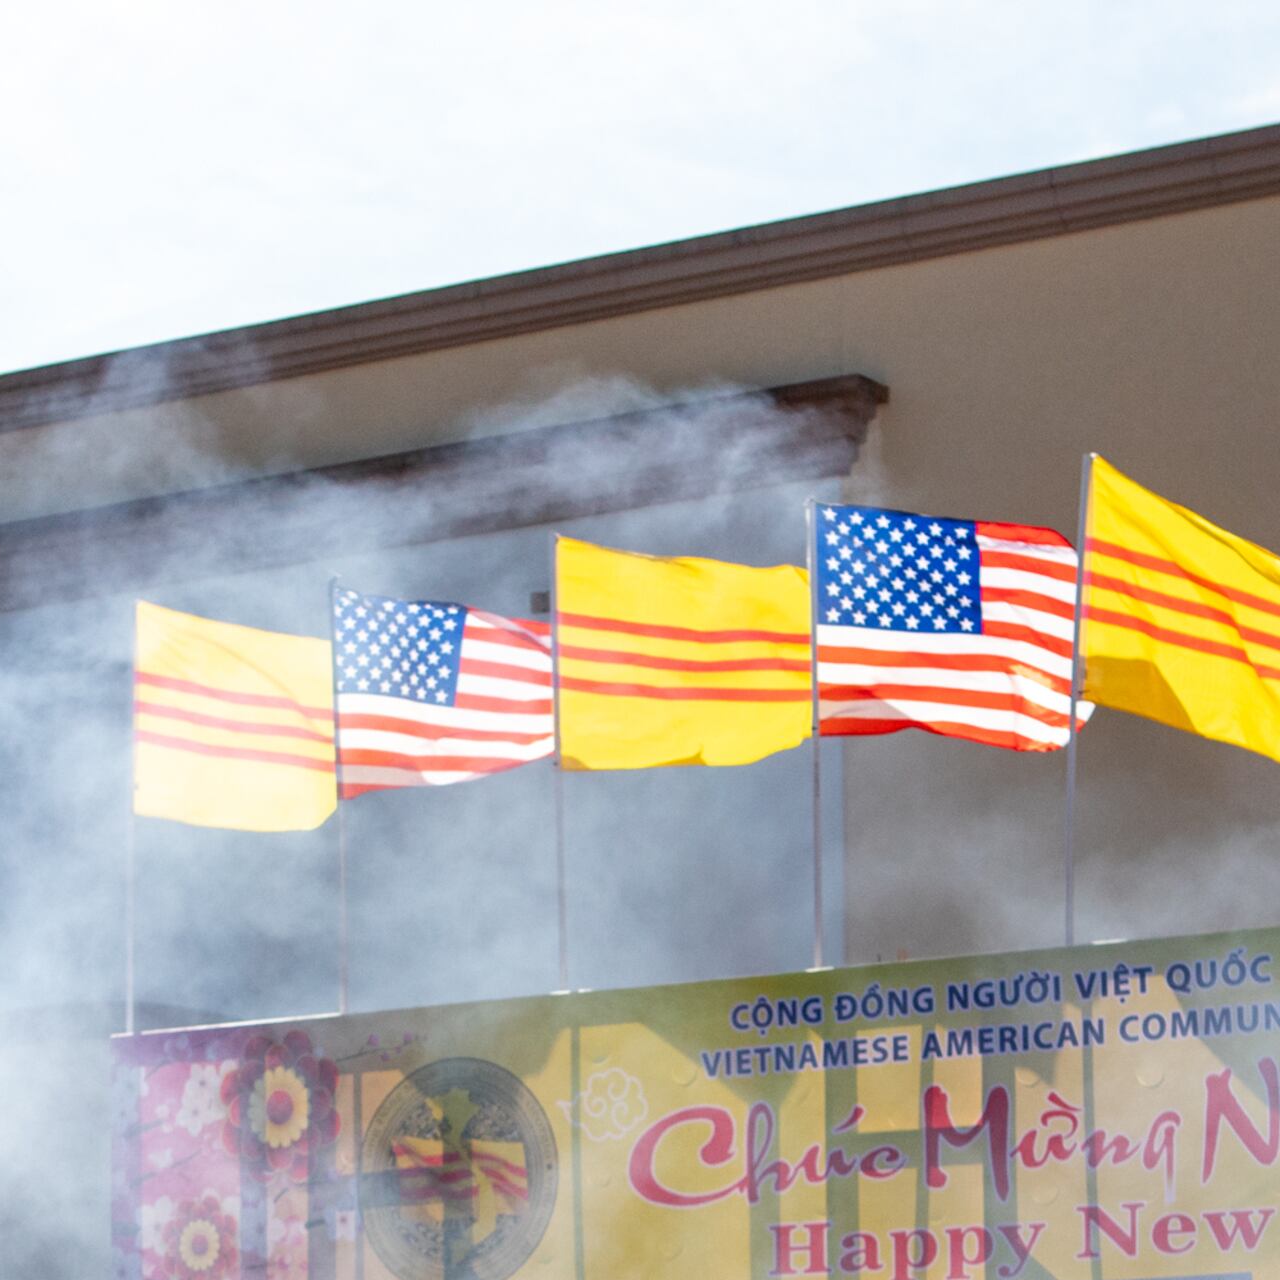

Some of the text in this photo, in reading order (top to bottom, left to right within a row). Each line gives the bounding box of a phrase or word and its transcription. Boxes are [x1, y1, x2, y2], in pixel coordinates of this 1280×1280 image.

[731, 997, 823, 1035] CỘNG
[835, 984, 934, 1022] ĐỒNG
[947, 971, 1061, 1011] NGƯỜI
[1075, 963, 1152, 1003] VIỆT
[1166, 948, 1271, 993] QUỐC
[702, 1035, 909, 1077] VIETNAMESE
[921, 1018, 1105, 1060] AMERICAN
[629, 1102, 907, 1207] Chúc
[922, 1084, 1181, 1203] Mừng
[1076, 1201, 1276, 1258] New
